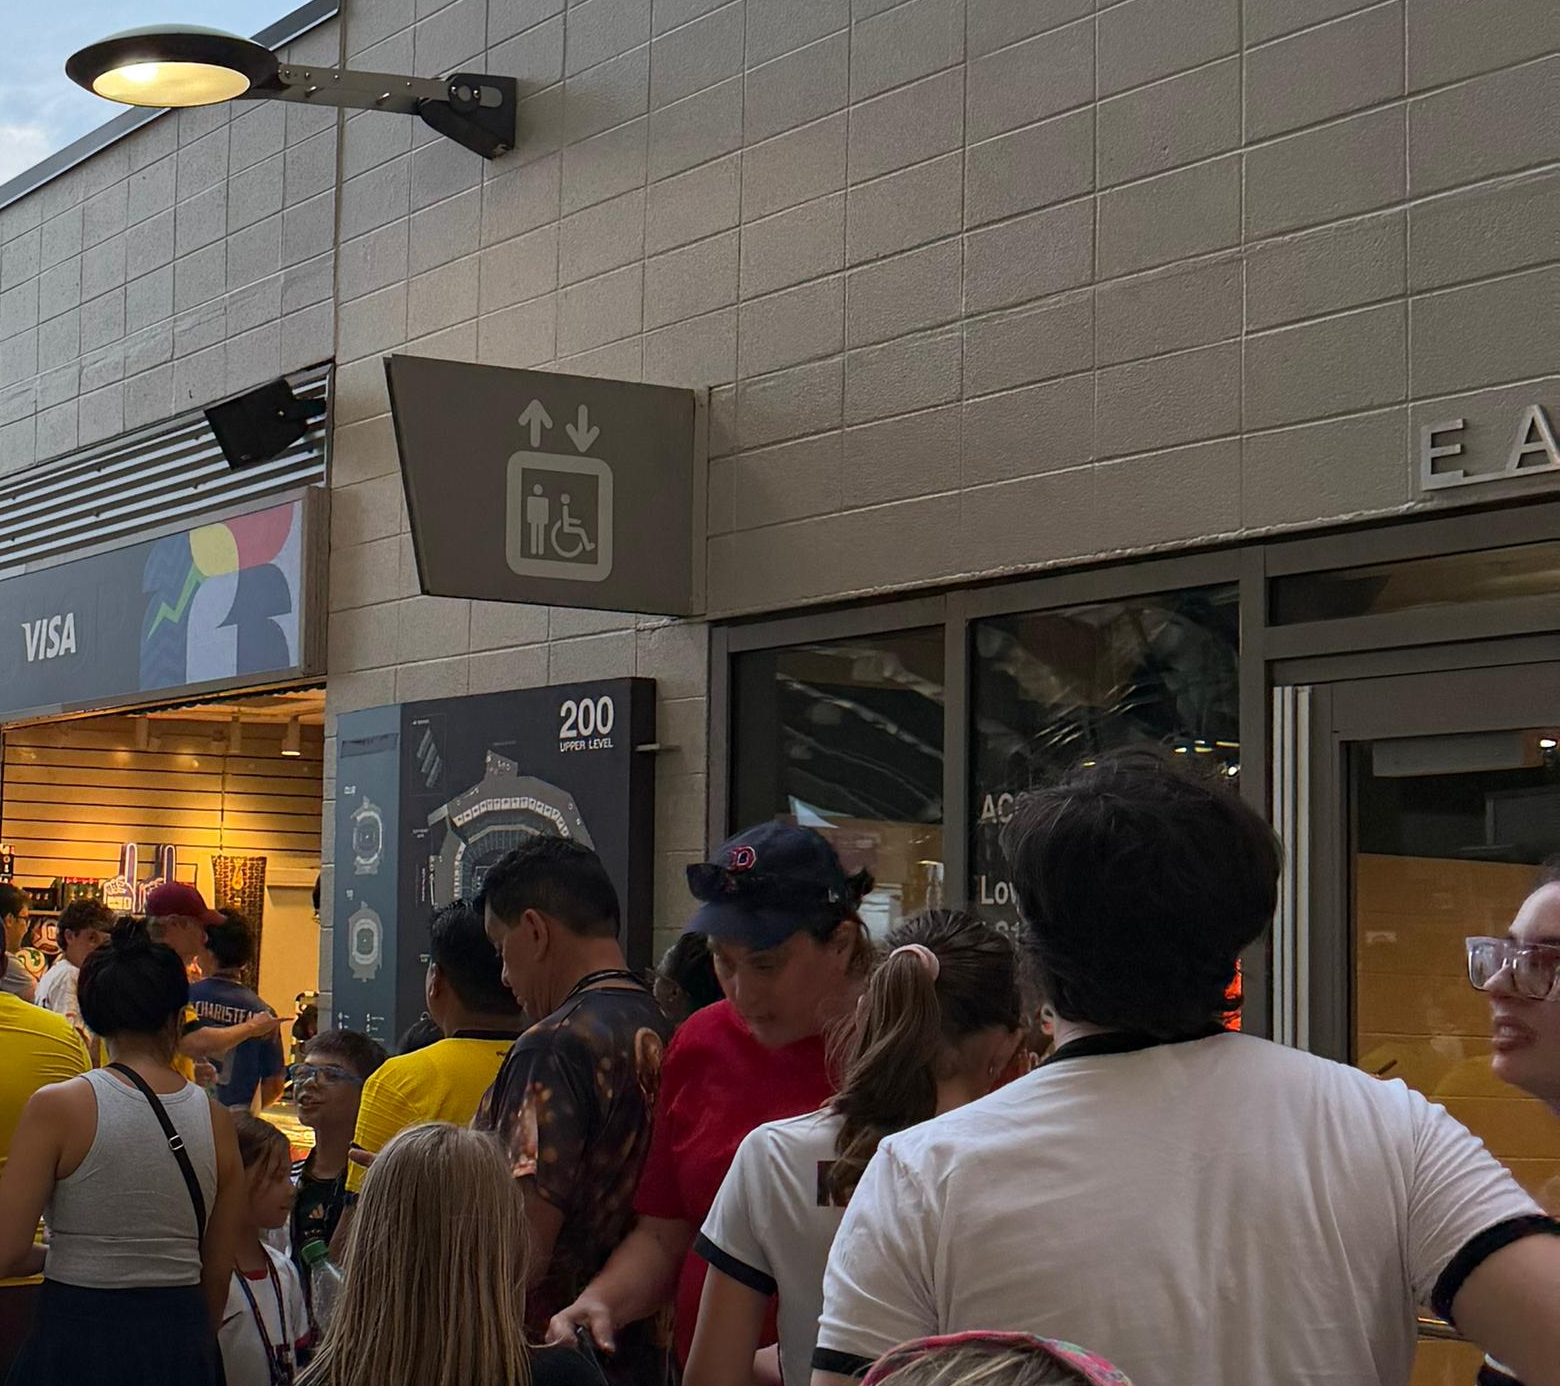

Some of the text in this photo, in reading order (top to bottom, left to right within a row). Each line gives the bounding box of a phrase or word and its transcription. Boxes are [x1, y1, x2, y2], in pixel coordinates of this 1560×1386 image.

[1420, 404, 1560, 491] EA
[21, 613, 76, 662] VISA
[560, 696, 614, 739] 200
[560, 738, 614, 752] UPPER LEVEL
